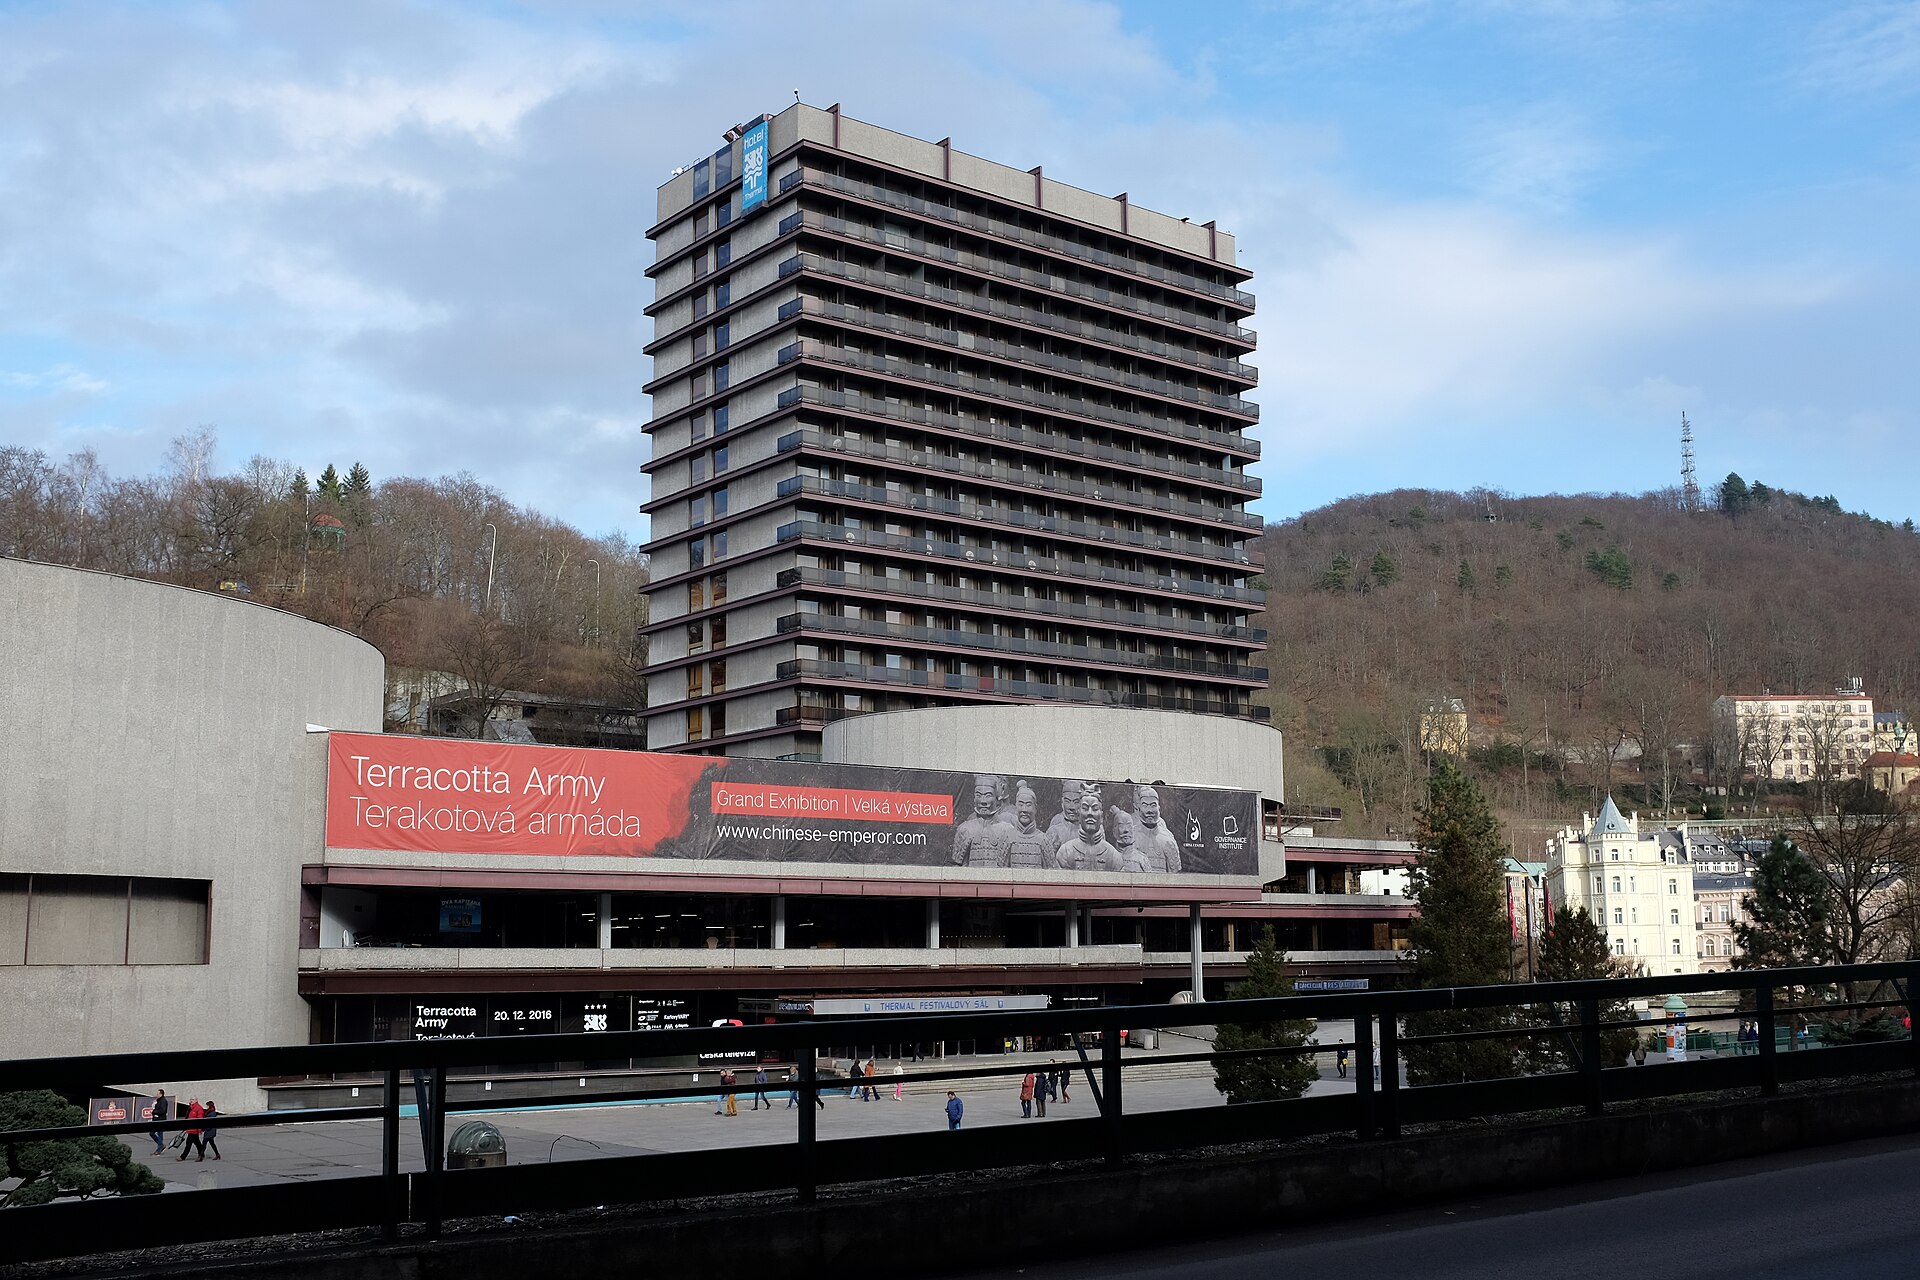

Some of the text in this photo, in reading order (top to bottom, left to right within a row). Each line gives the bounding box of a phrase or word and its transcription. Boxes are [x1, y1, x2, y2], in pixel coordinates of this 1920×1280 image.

[350, 755, 606, 804] Terracotta Army
[716, 789, 948, 819] Grand Exhibition Velká výstava
[349, 796, 641, 838] Terakotová armáda
[716, 824, 927, 847] www.chinese-emperor.com
[416, 1005, 477, 1017] Terracotta
[880, 999, 989, 1011] THERMAL FESTIVALOVÝ SÁL
[415, 1016, 449, 1029] Army
[494, 1010, 552, 1021] 20. 12. 2016
